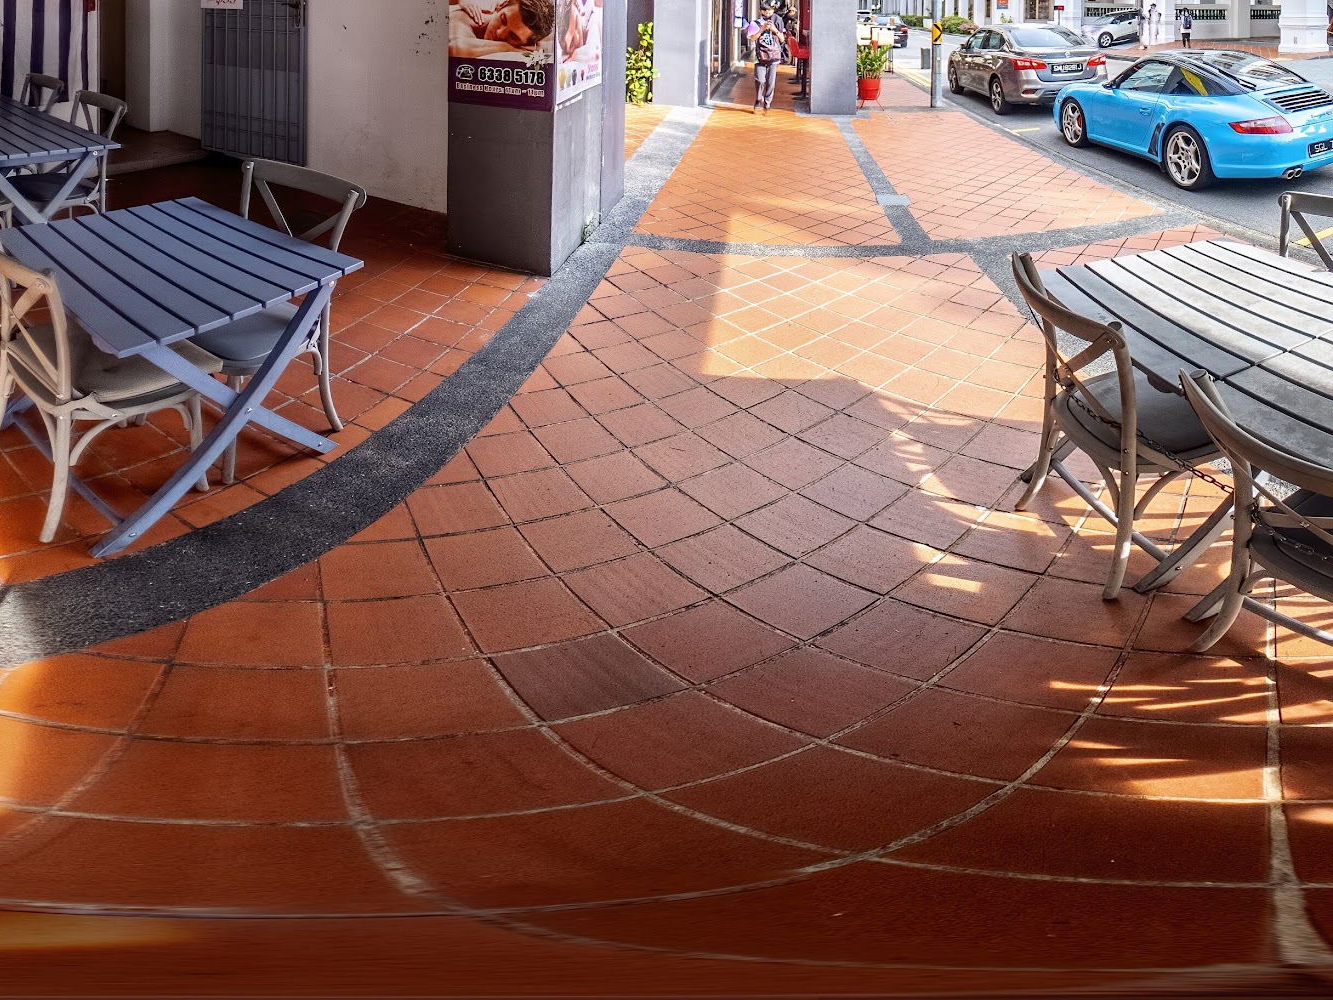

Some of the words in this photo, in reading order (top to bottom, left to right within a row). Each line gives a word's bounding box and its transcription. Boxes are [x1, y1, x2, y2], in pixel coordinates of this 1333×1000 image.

[478, 66, 513, 83] 6338
[513, 68, 546, 86] 5178
[1314, 142, 1329, 153] SGL
